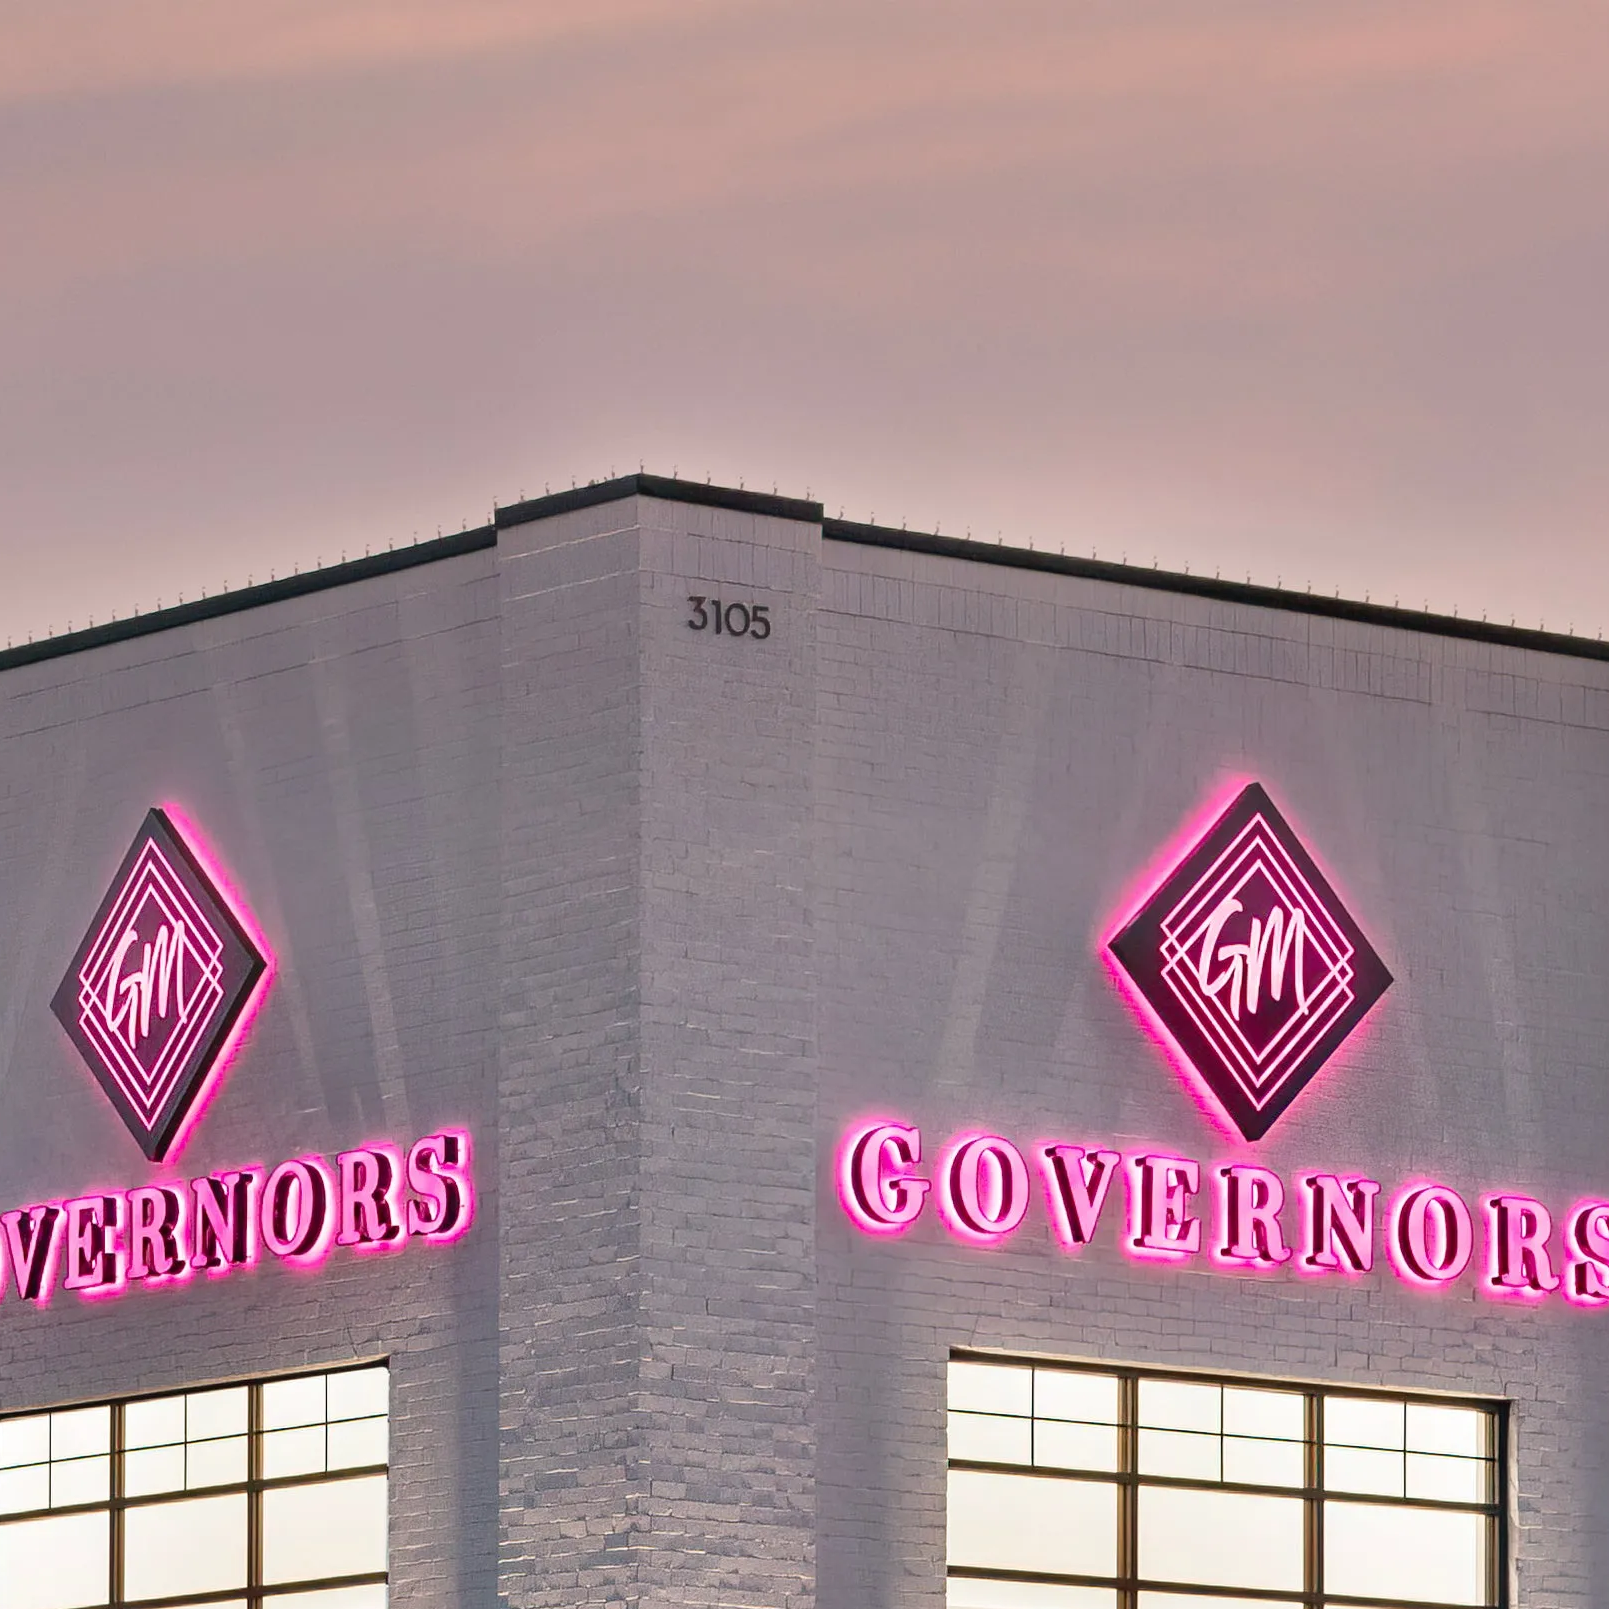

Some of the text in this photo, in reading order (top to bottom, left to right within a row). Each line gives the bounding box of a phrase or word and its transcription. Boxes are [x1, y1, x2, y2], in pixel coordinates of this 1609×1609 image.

[687, 595, 771, 640] 3105
[105, 919, 188, 1050] GM
[1197, 898, 1310, 1022] GM
